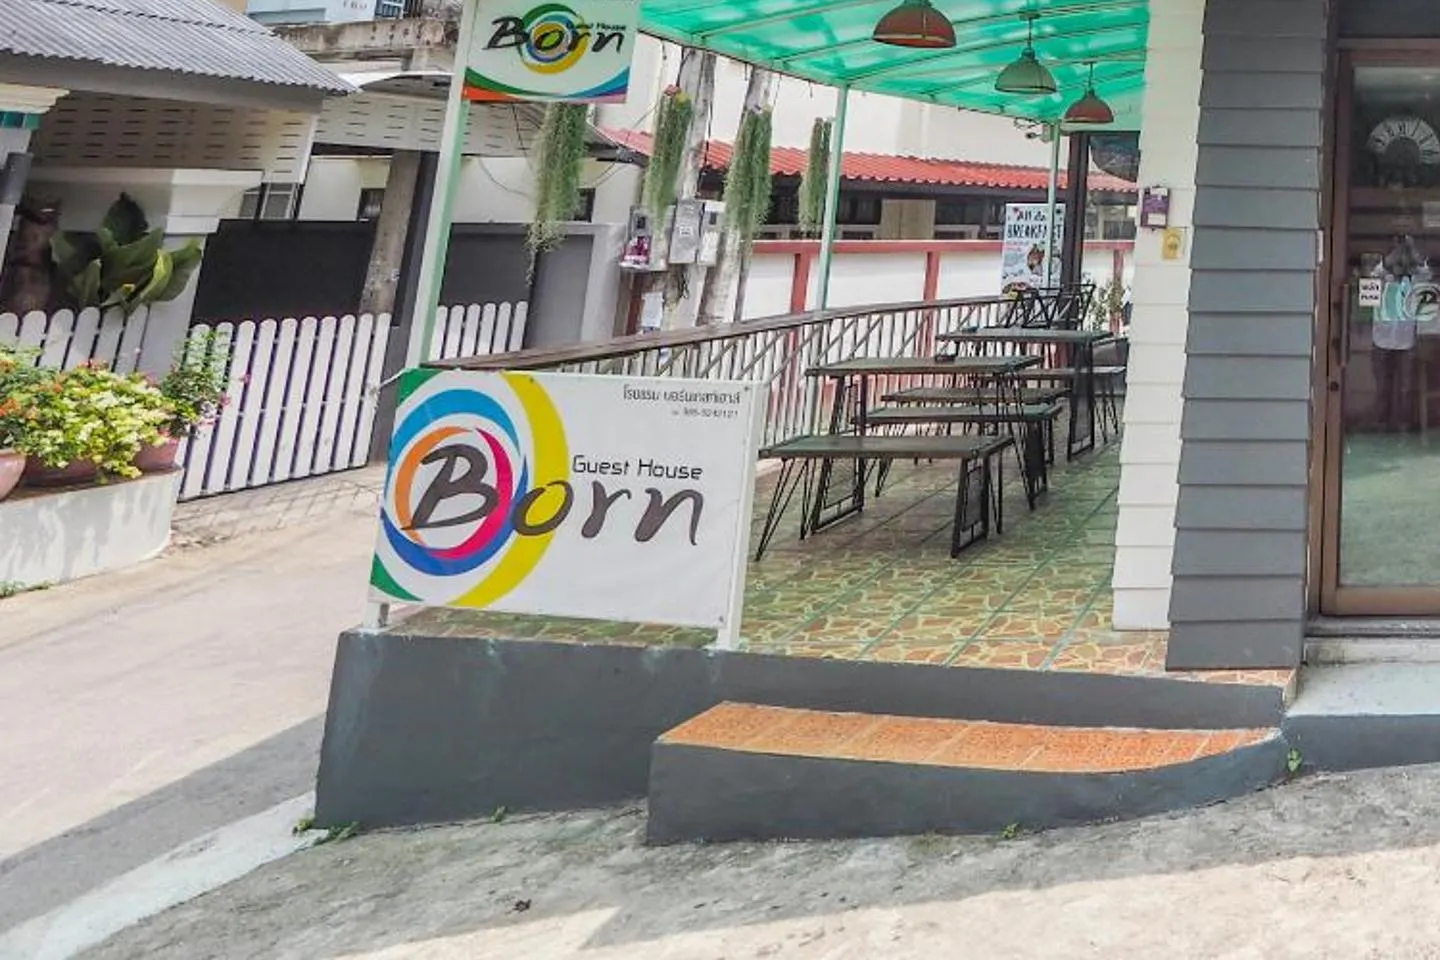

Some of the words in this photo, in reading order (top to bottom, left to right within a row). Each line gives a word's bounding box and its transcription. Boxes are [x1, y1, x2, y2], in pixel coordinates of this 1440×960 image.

[482, 15, 626, 55] Born
[572, 454, 630, 476] Guest
[637, 458, 704, 481] House
[400, 443, 704, 547] Born
